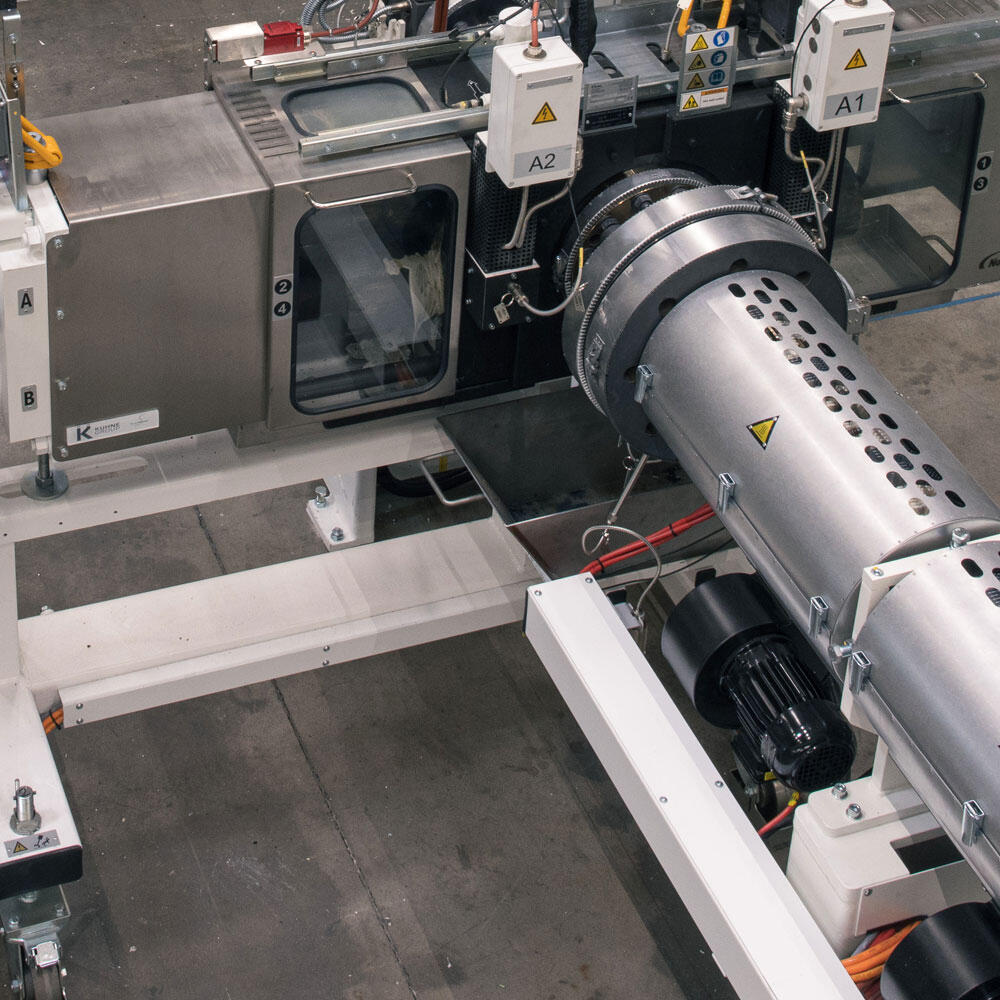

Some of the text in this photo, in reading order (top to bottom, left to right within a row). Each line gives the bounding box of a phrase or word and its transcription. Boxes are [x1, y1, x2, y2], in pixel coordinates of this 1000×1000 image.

[834, 93, 864, 116] A1
[528, 153, 556, 173] A2
[279, 281, 288, 293] 2
[20, 293, 33, 309] A
[278, 303, 287, 314] 4
[24, 390, 35, 407] B
[76, 425, 93, 442] K
